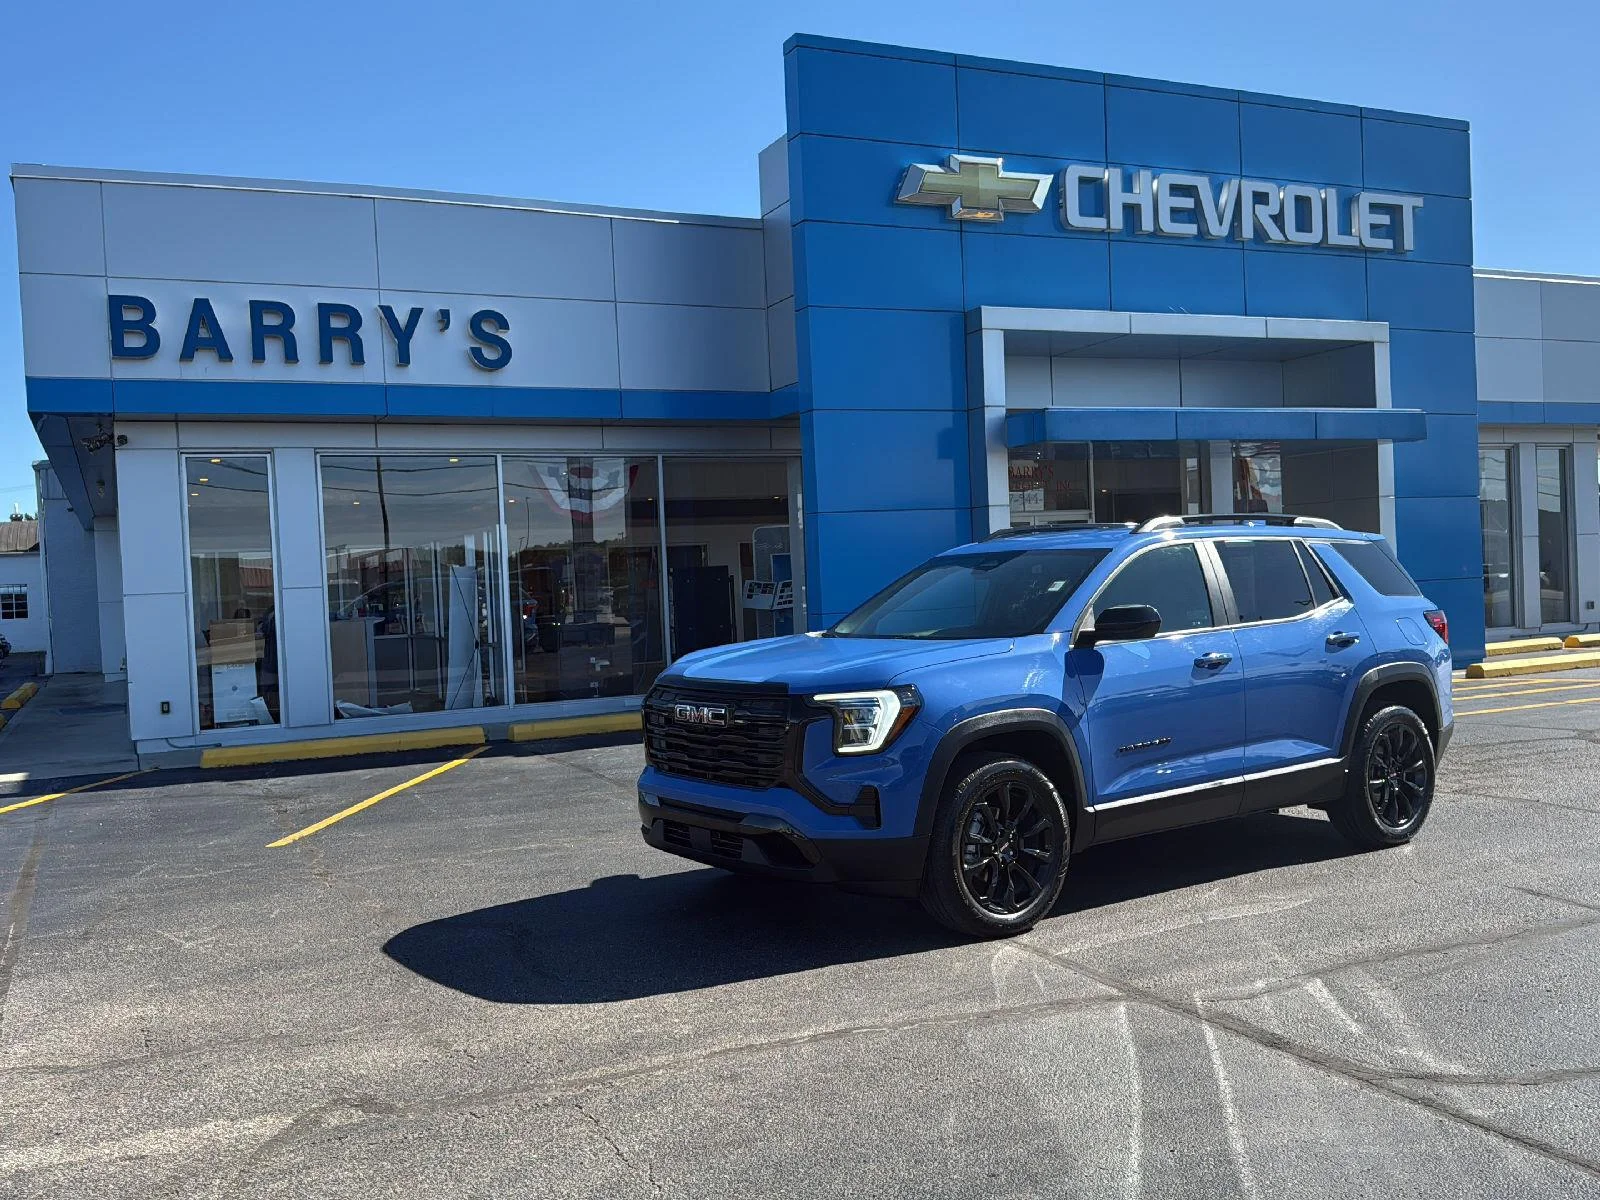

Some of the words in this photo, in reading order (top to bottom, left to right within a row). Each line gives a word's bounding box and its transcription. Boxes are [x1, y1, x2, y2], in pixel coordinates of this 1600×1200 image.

[1058, 164, 1424, 253] CHEVROLET
[108, 294, 514, 371] BARRY'S
[675, 704, 725, 726] GMC
